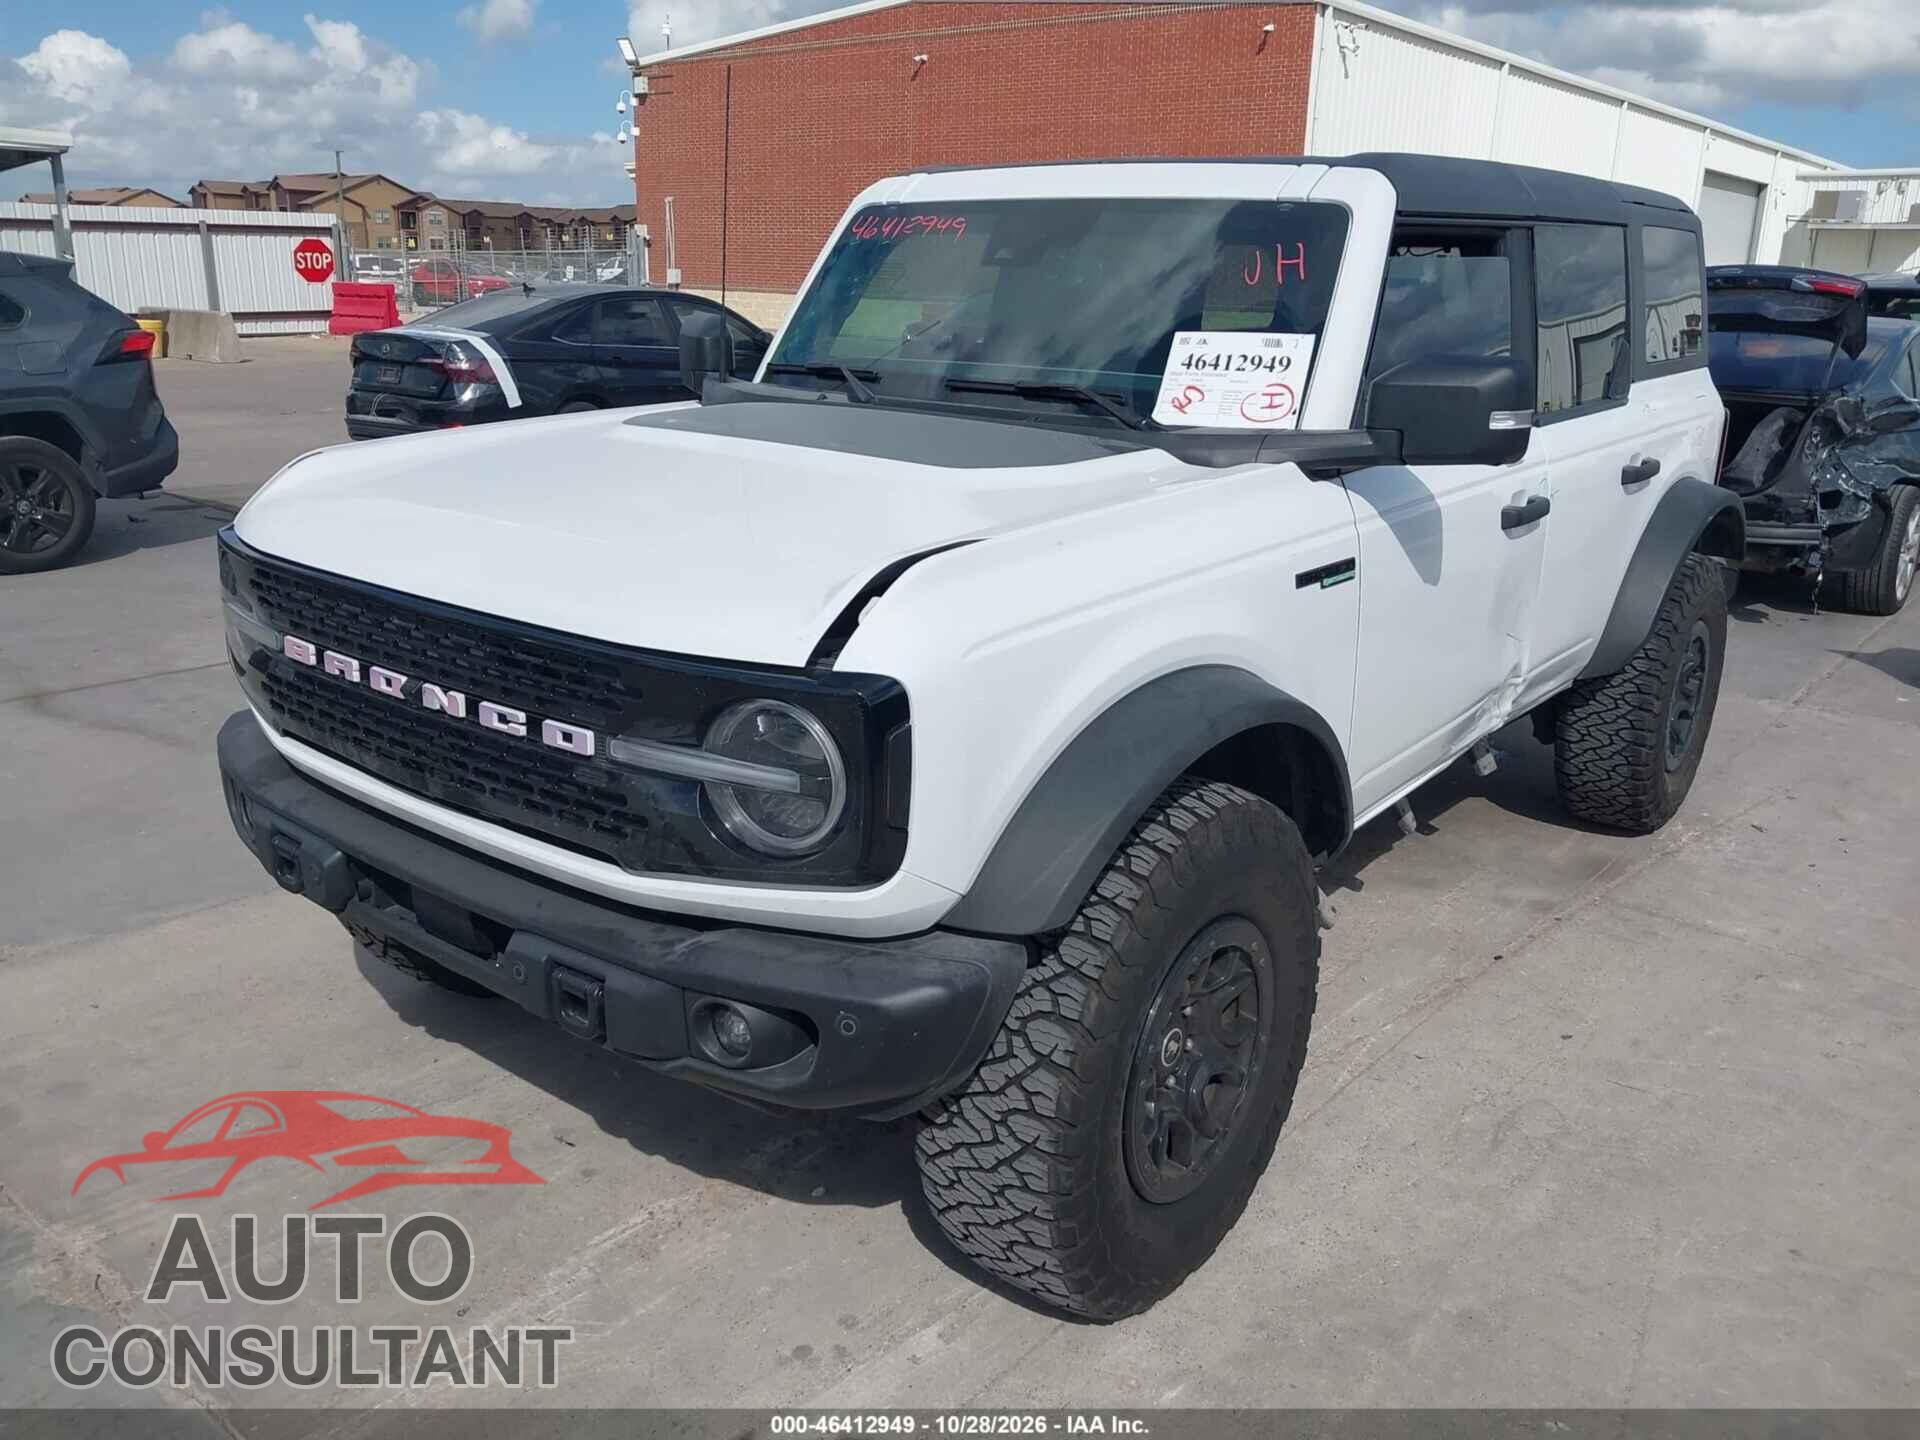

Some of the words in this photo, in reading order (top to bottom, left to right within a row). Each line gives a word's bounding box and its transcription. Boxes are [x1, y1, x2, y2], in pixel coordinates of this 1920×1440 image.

[296, 252, 332, 269] STOP
[1181, 353, 1292, 373] 46412949
[284, 635, 595, 756] BRONCO
